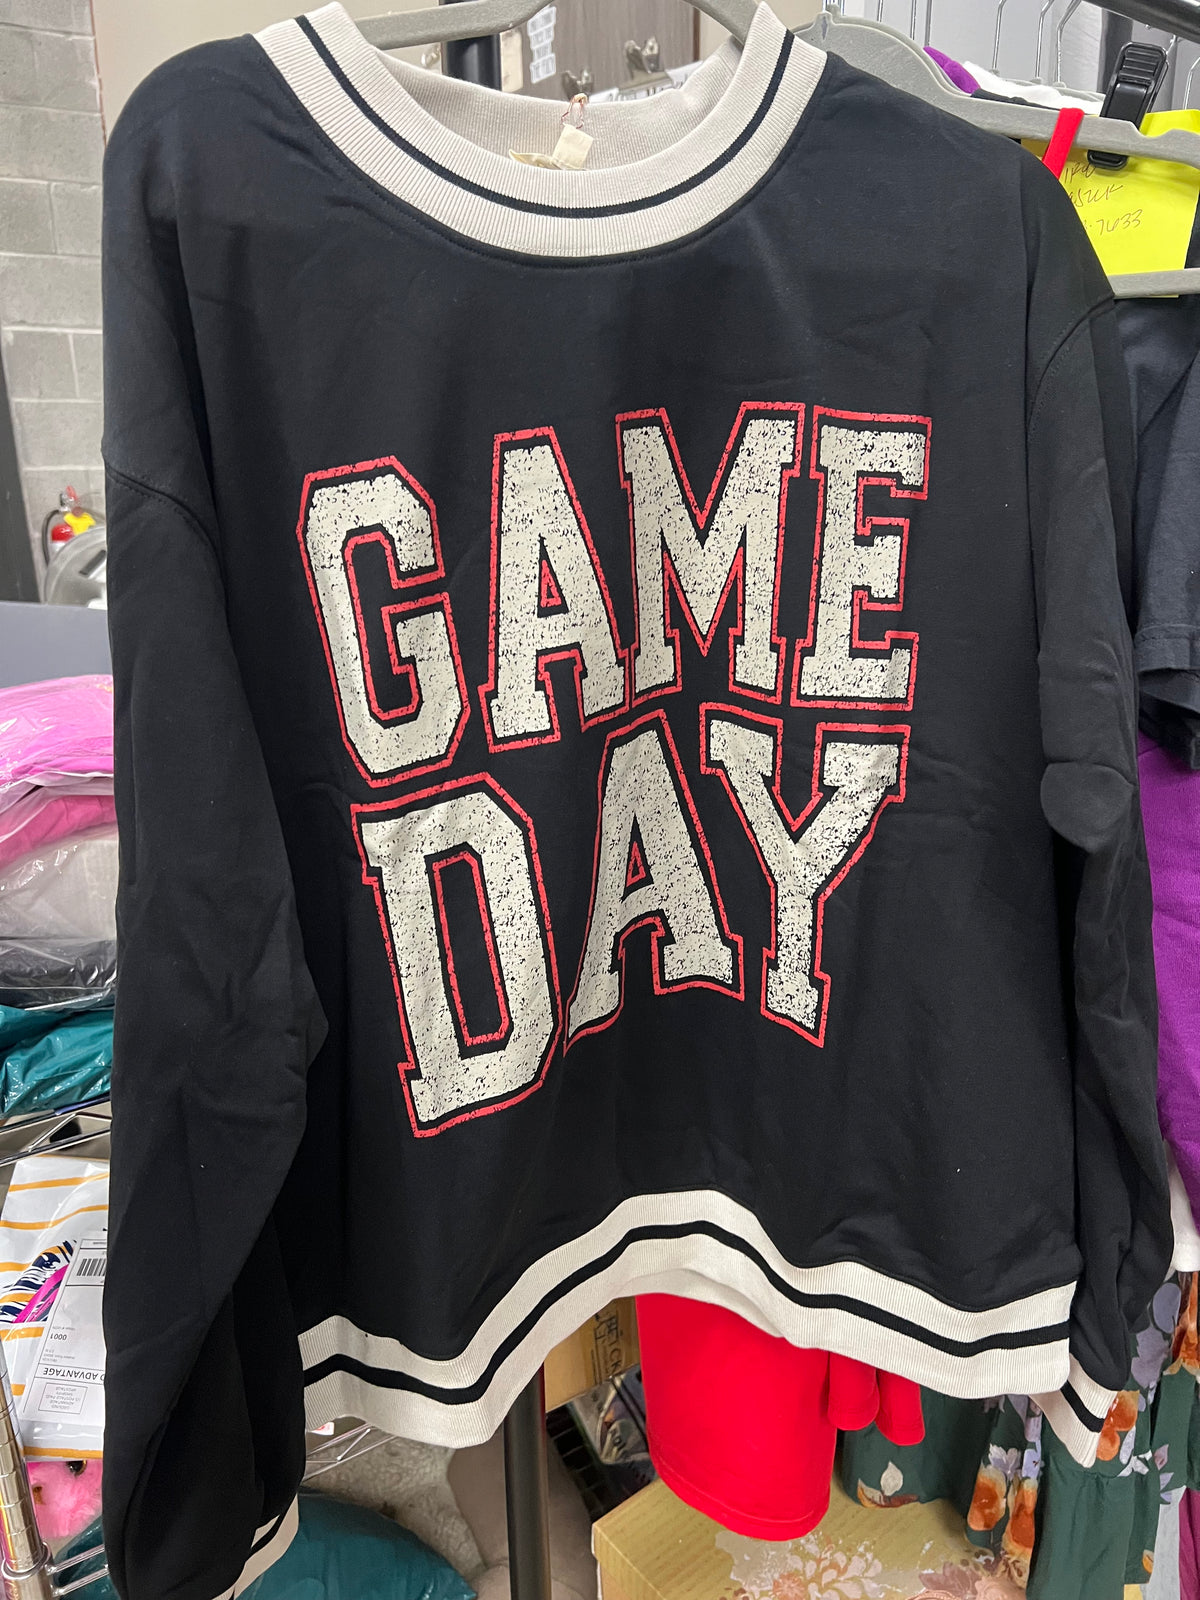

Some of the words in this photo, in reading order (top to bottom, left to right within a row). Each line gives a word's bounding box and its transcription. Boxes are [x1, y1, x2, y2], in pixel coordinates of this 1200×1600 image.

[297, 402, 932, 786] GAME
[352, 703, 911, 1138] DAY
[43, 1367, 99, 1381] ADVANTAGE
[50, 1333, 67, 1341] 0001
